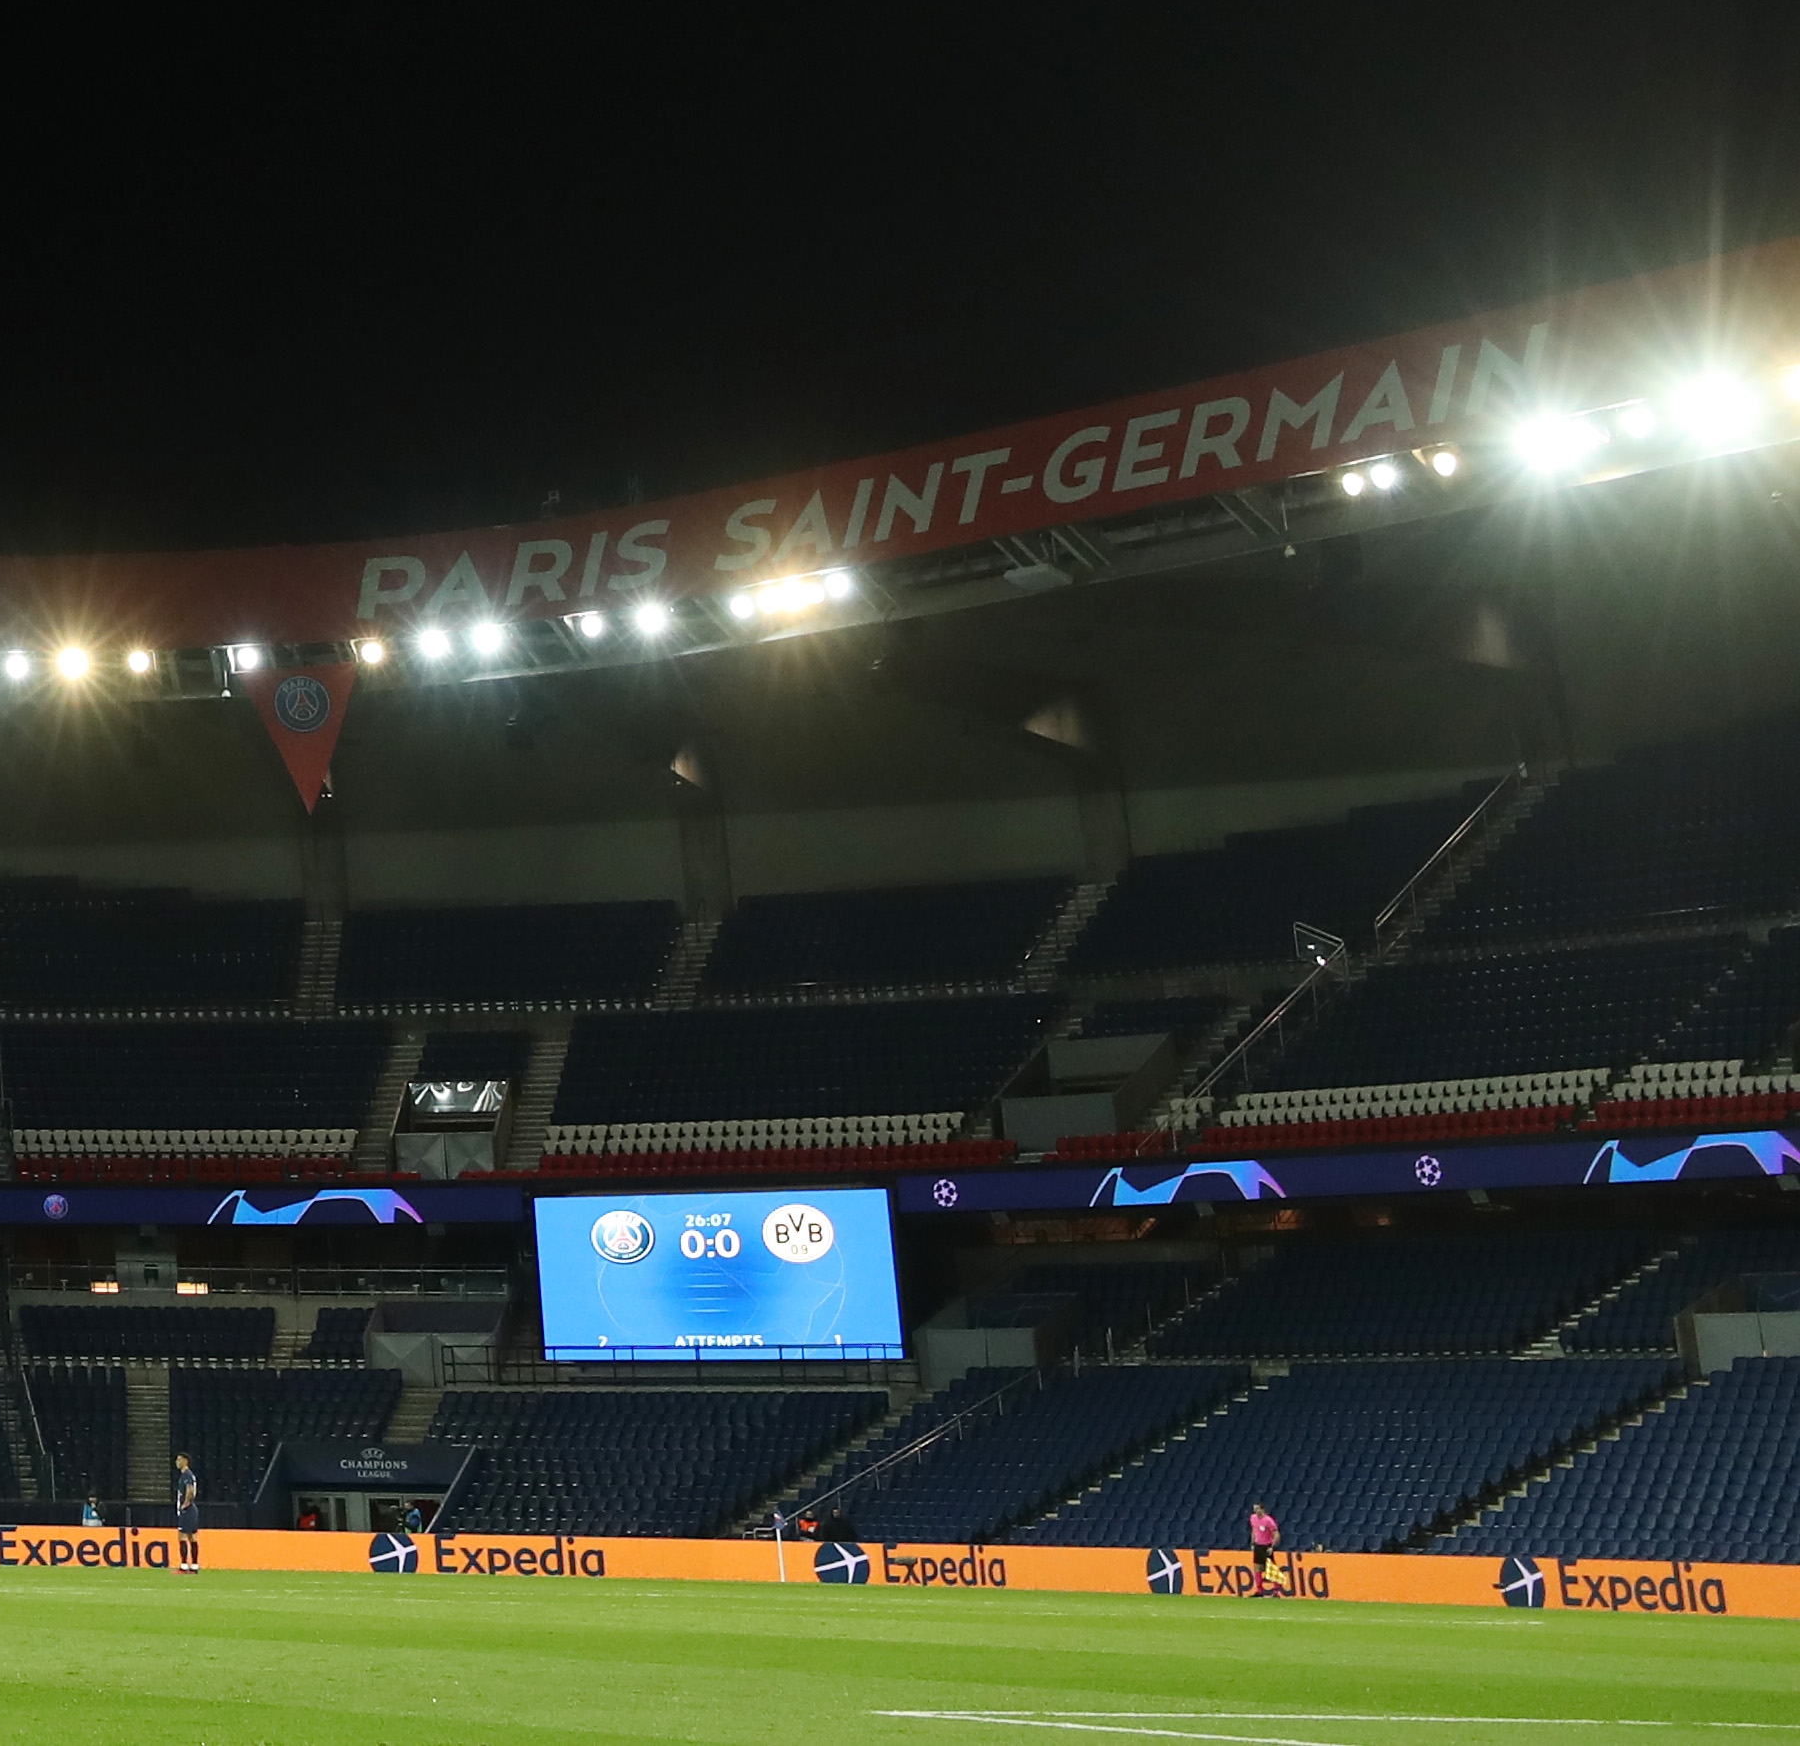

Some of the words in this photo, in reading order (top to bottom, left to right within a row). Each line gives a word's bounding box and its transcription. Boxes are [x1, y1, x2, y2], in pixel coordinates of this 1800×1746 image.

[355, 518, 669, 621] PARIS
[714, 321, 1550, 573] SAINT-GERMAIN
[685, 1213, 732, 1228] 26:07
[775, 1213, 824, 1244] BVB
[680, 1229, 741, 1259] 0:0
[790, 1245, 809, 1256] 09
[339, 1459, 408, 1470] CHAMPIONS
[357, 1470, 392, 1479] LEAGUE
[435, 1534, 606, 1576] Expedia
[883, 1543, 1006, 1587] Expedia
[1194, 1550, 1330, 1598] Expdia
[1558, 1558, 1727, 1614] Expedia
